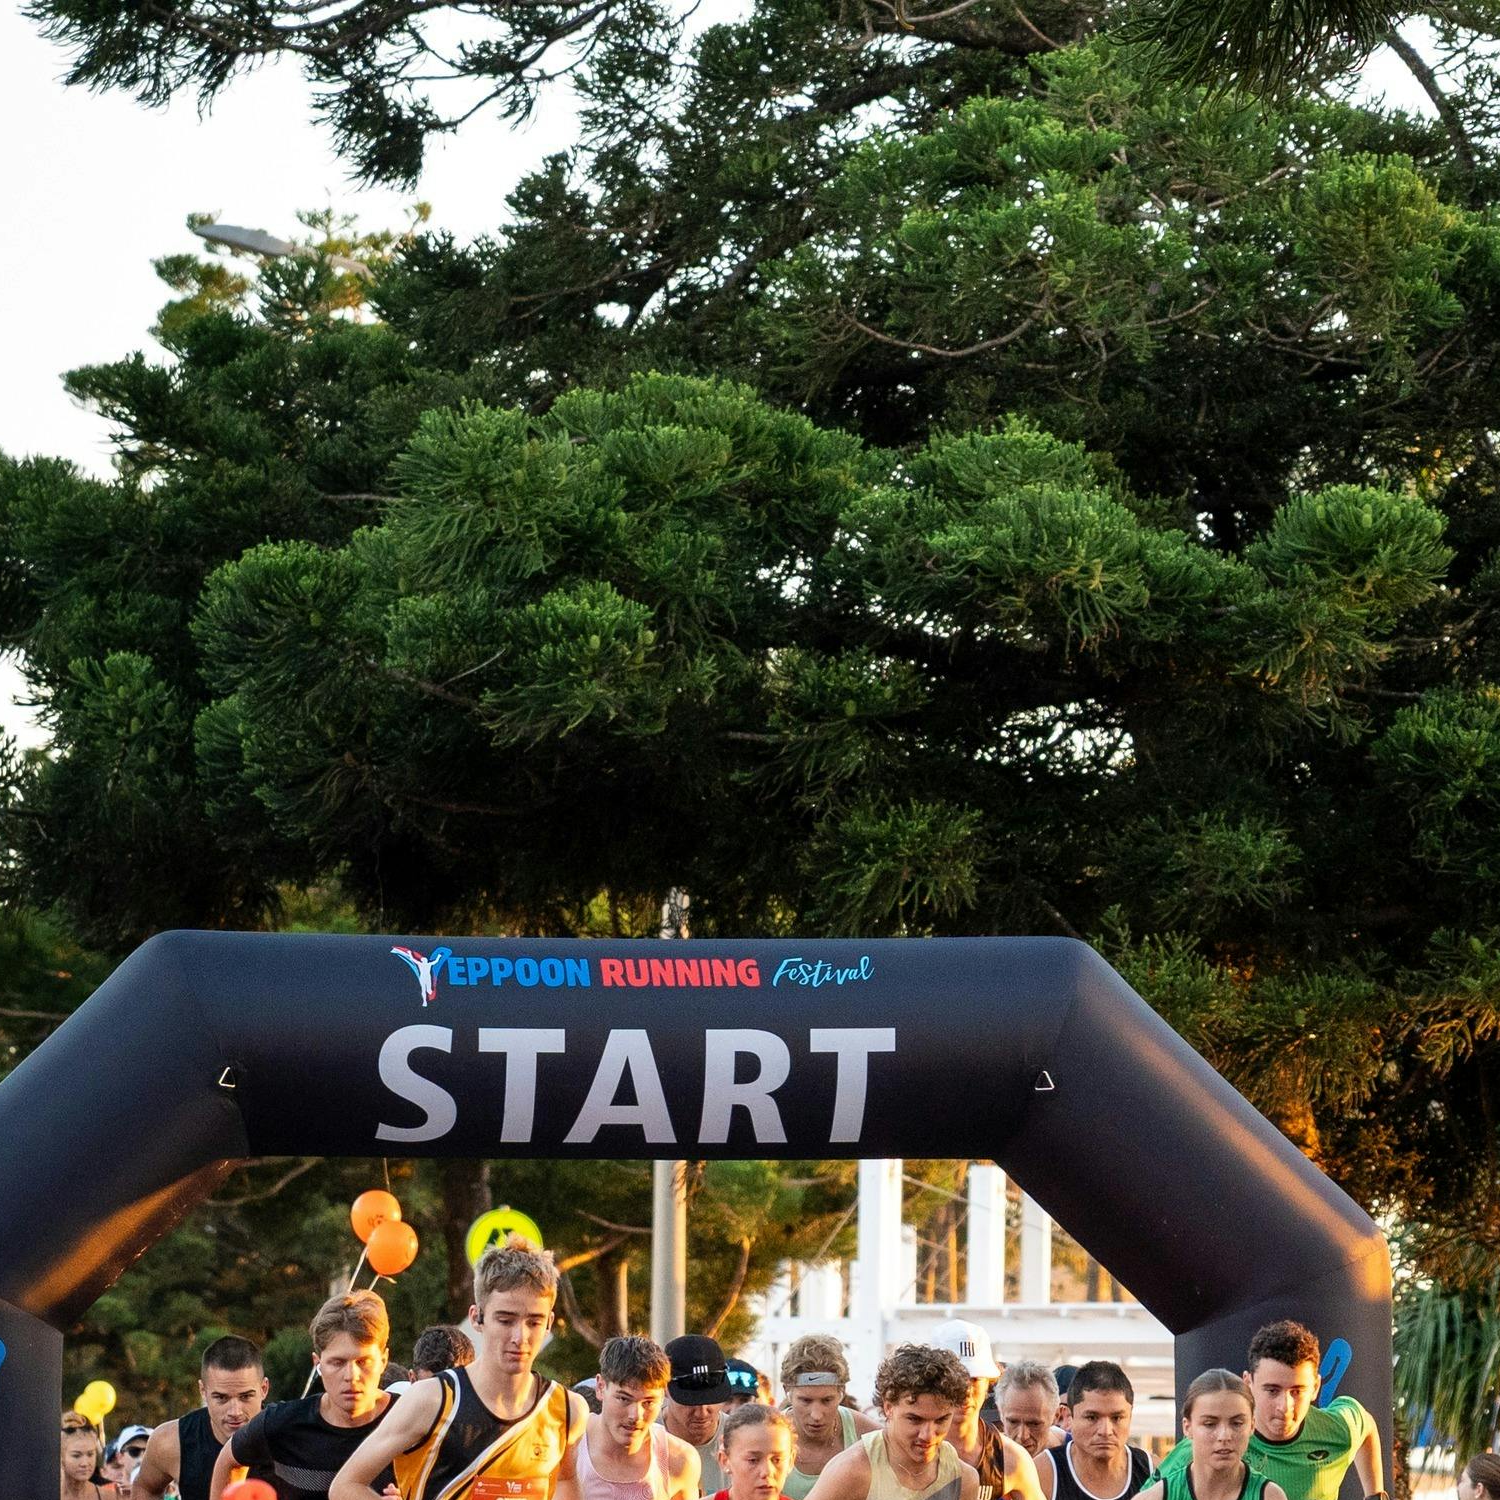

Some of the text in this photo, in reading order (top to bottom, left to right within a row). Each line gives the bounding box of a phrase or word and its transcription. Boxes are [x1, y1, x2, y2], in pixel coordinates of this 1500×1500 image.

[601, 958, 760, 987] RUNNING
[773, 955, 874, 987] Festival
[374, 1024, 896, 1144] START
